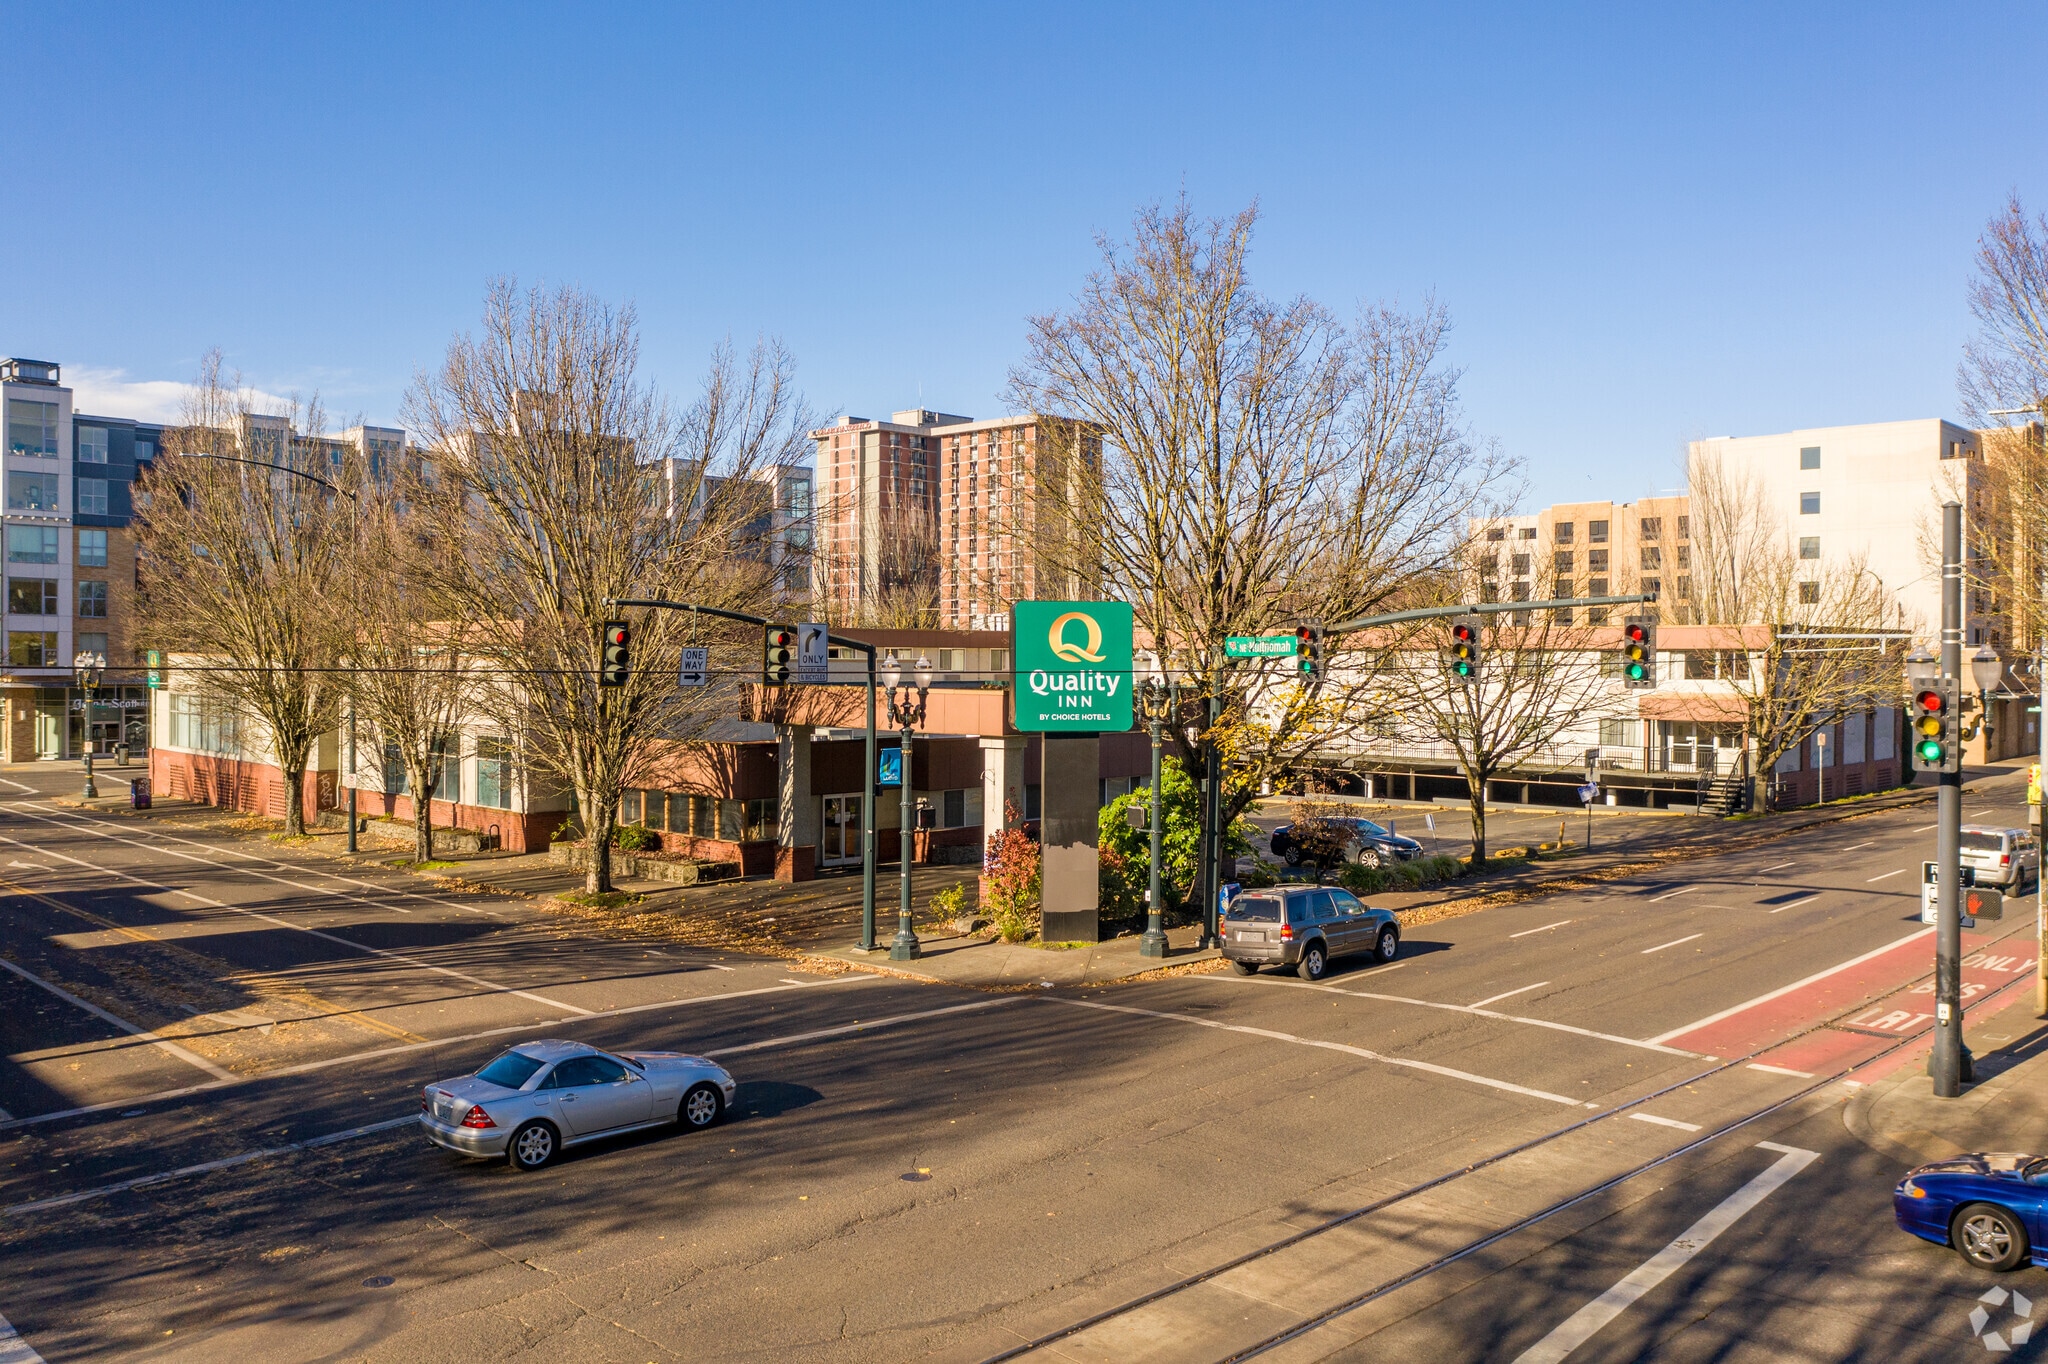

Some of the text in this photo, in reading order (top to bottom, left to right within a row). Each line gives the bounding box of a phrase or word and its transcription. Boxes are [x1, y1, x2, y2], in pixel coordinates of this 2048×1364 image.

[1048, 611, 1107, 663] Q
[685, 650, 704, 660] ONE
[802, 655, 824, 664] ONLY
[684, 661, 704, 670] WAY
[1029, 669, 1121, 697] Quality
[1058, 695, 1093, 708] INN
[1039, 713, 1111, 721] BY CHOICE HOTELS
[1961, 953, 2038, 973] ONLY
[1910, 980, 1986, 999] BS
[1845, 1007, 1935, 1032] LRT
